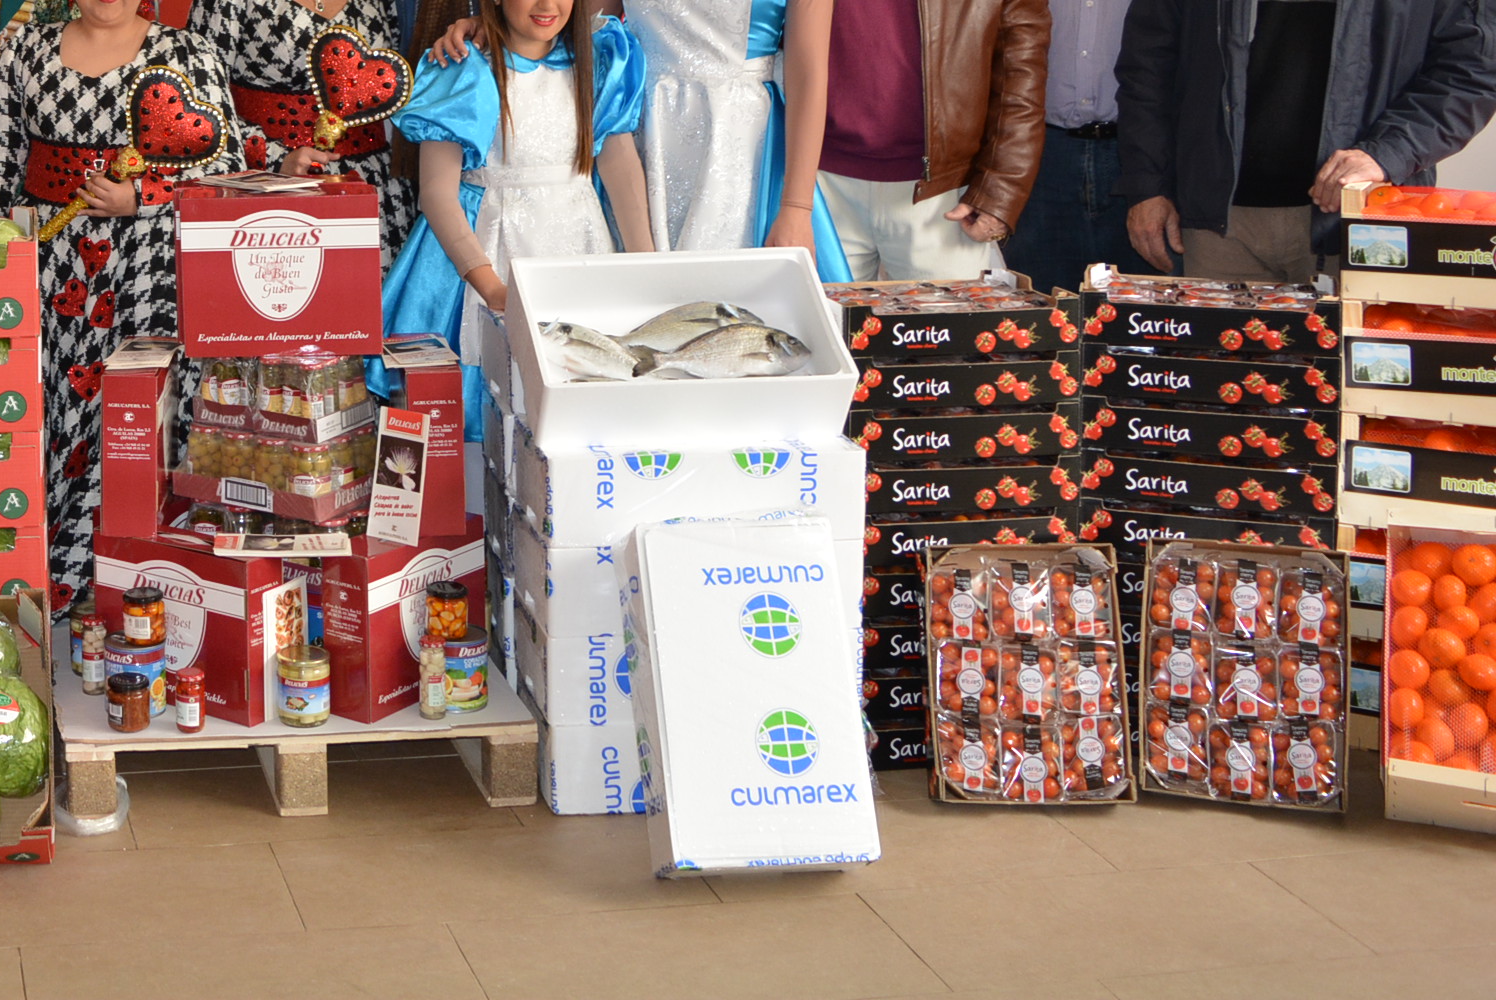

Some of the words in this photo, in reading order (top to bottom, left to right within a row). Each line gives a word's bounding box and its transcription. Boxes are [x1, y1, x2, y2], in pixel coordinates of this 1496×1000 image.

[229, 227, 322, 248] DELICIAS
[249, 252, 267, 265] Un
[271, 252, 305, 267] Toque
[1438, 247, 1494, 265] monte
[254, 267, 267, 279] de
[270, 267, 300, 279] Buen
[262, 283, 294, 298] Gusto
[892, 322, 951, 346] Sarita
[1127, 312, 1192, 337] Sarita
[197, 332, 252, 344] Especialistas
[254, 335, 264, 343] en
[265, 331, 314, 343] Alcaparras
[315, 334, 322, 343] y
[322, 329, 370, 341] Encurtidos
[892, 374, 951, 398] Sarita
[1127, 364, 1192, 389] Sarita
[201, 408, 246, 426] DELICIAS
[261, 418, 308, 437] DELICIAS
[388, 416, 422, 431] DELICIAS
[892, 428, 951, 450] Sarita
[1127, 417, 1192, 442] Sarita
[892, 479, 951, 503] Sarita
[1125, 468, 1189, 494] Sarita
[702, 563, 824, 587] culmarex
[890, 634, 921, 657] Sar
[889, 737, 926, 760] Sari
[730, 782, 858, 807] culmarex
